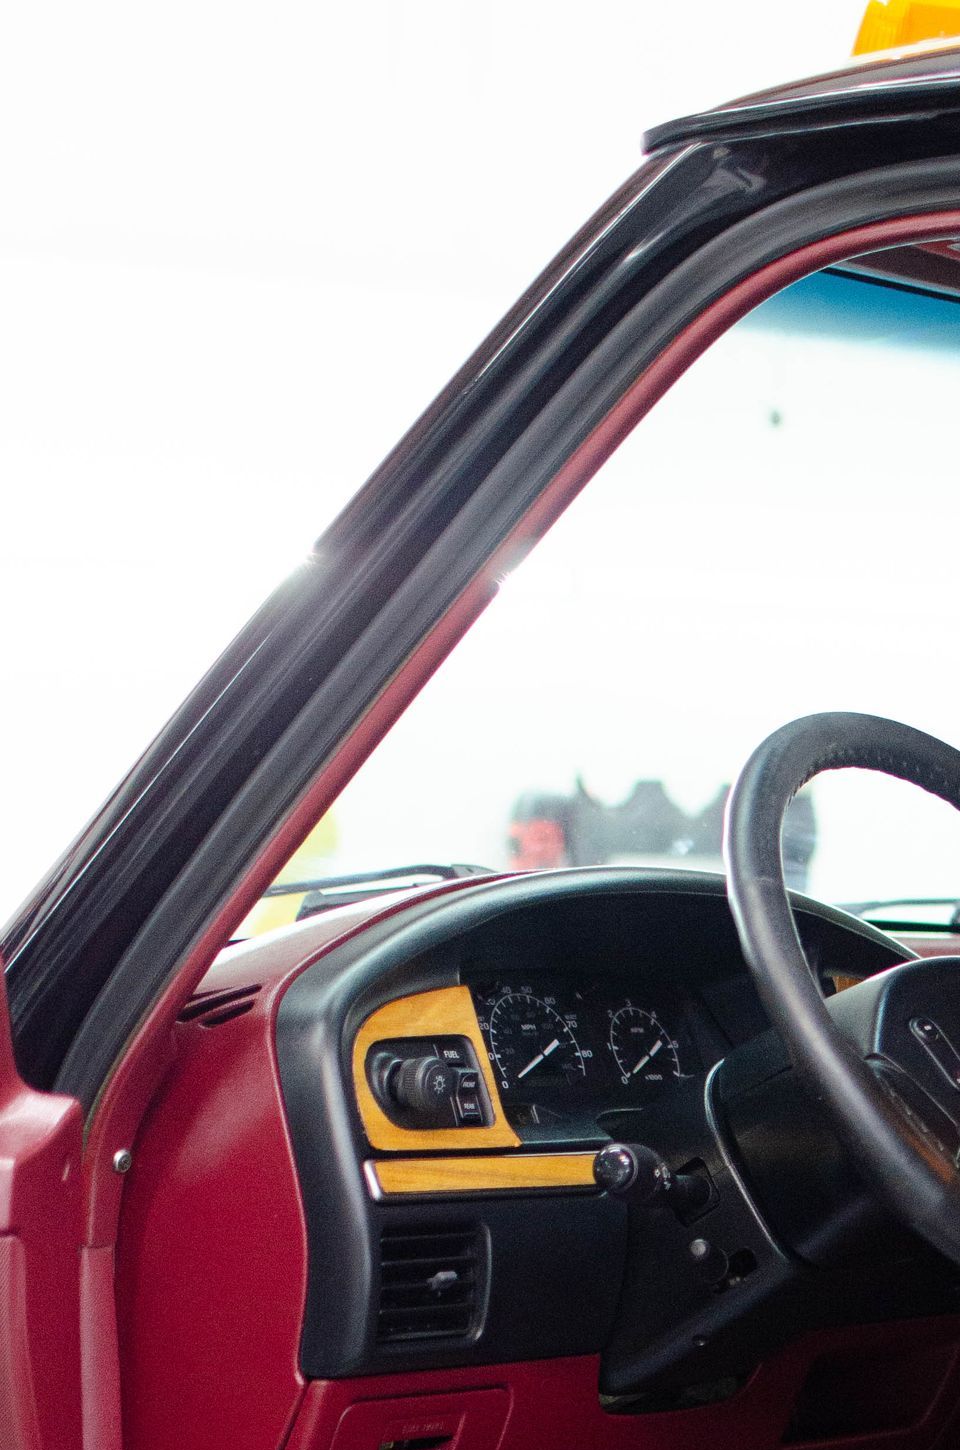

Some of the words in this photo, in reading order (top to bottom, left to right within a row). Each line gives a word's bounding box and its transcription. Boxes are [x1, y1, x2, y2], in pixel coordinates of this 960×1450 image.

[443, 1050, 460, 1059] FUEL
[581, 1049, 593, 1058] 80
[501, 1080, 509, 1089] 0
[620, 1075, 629, 1085] 0
